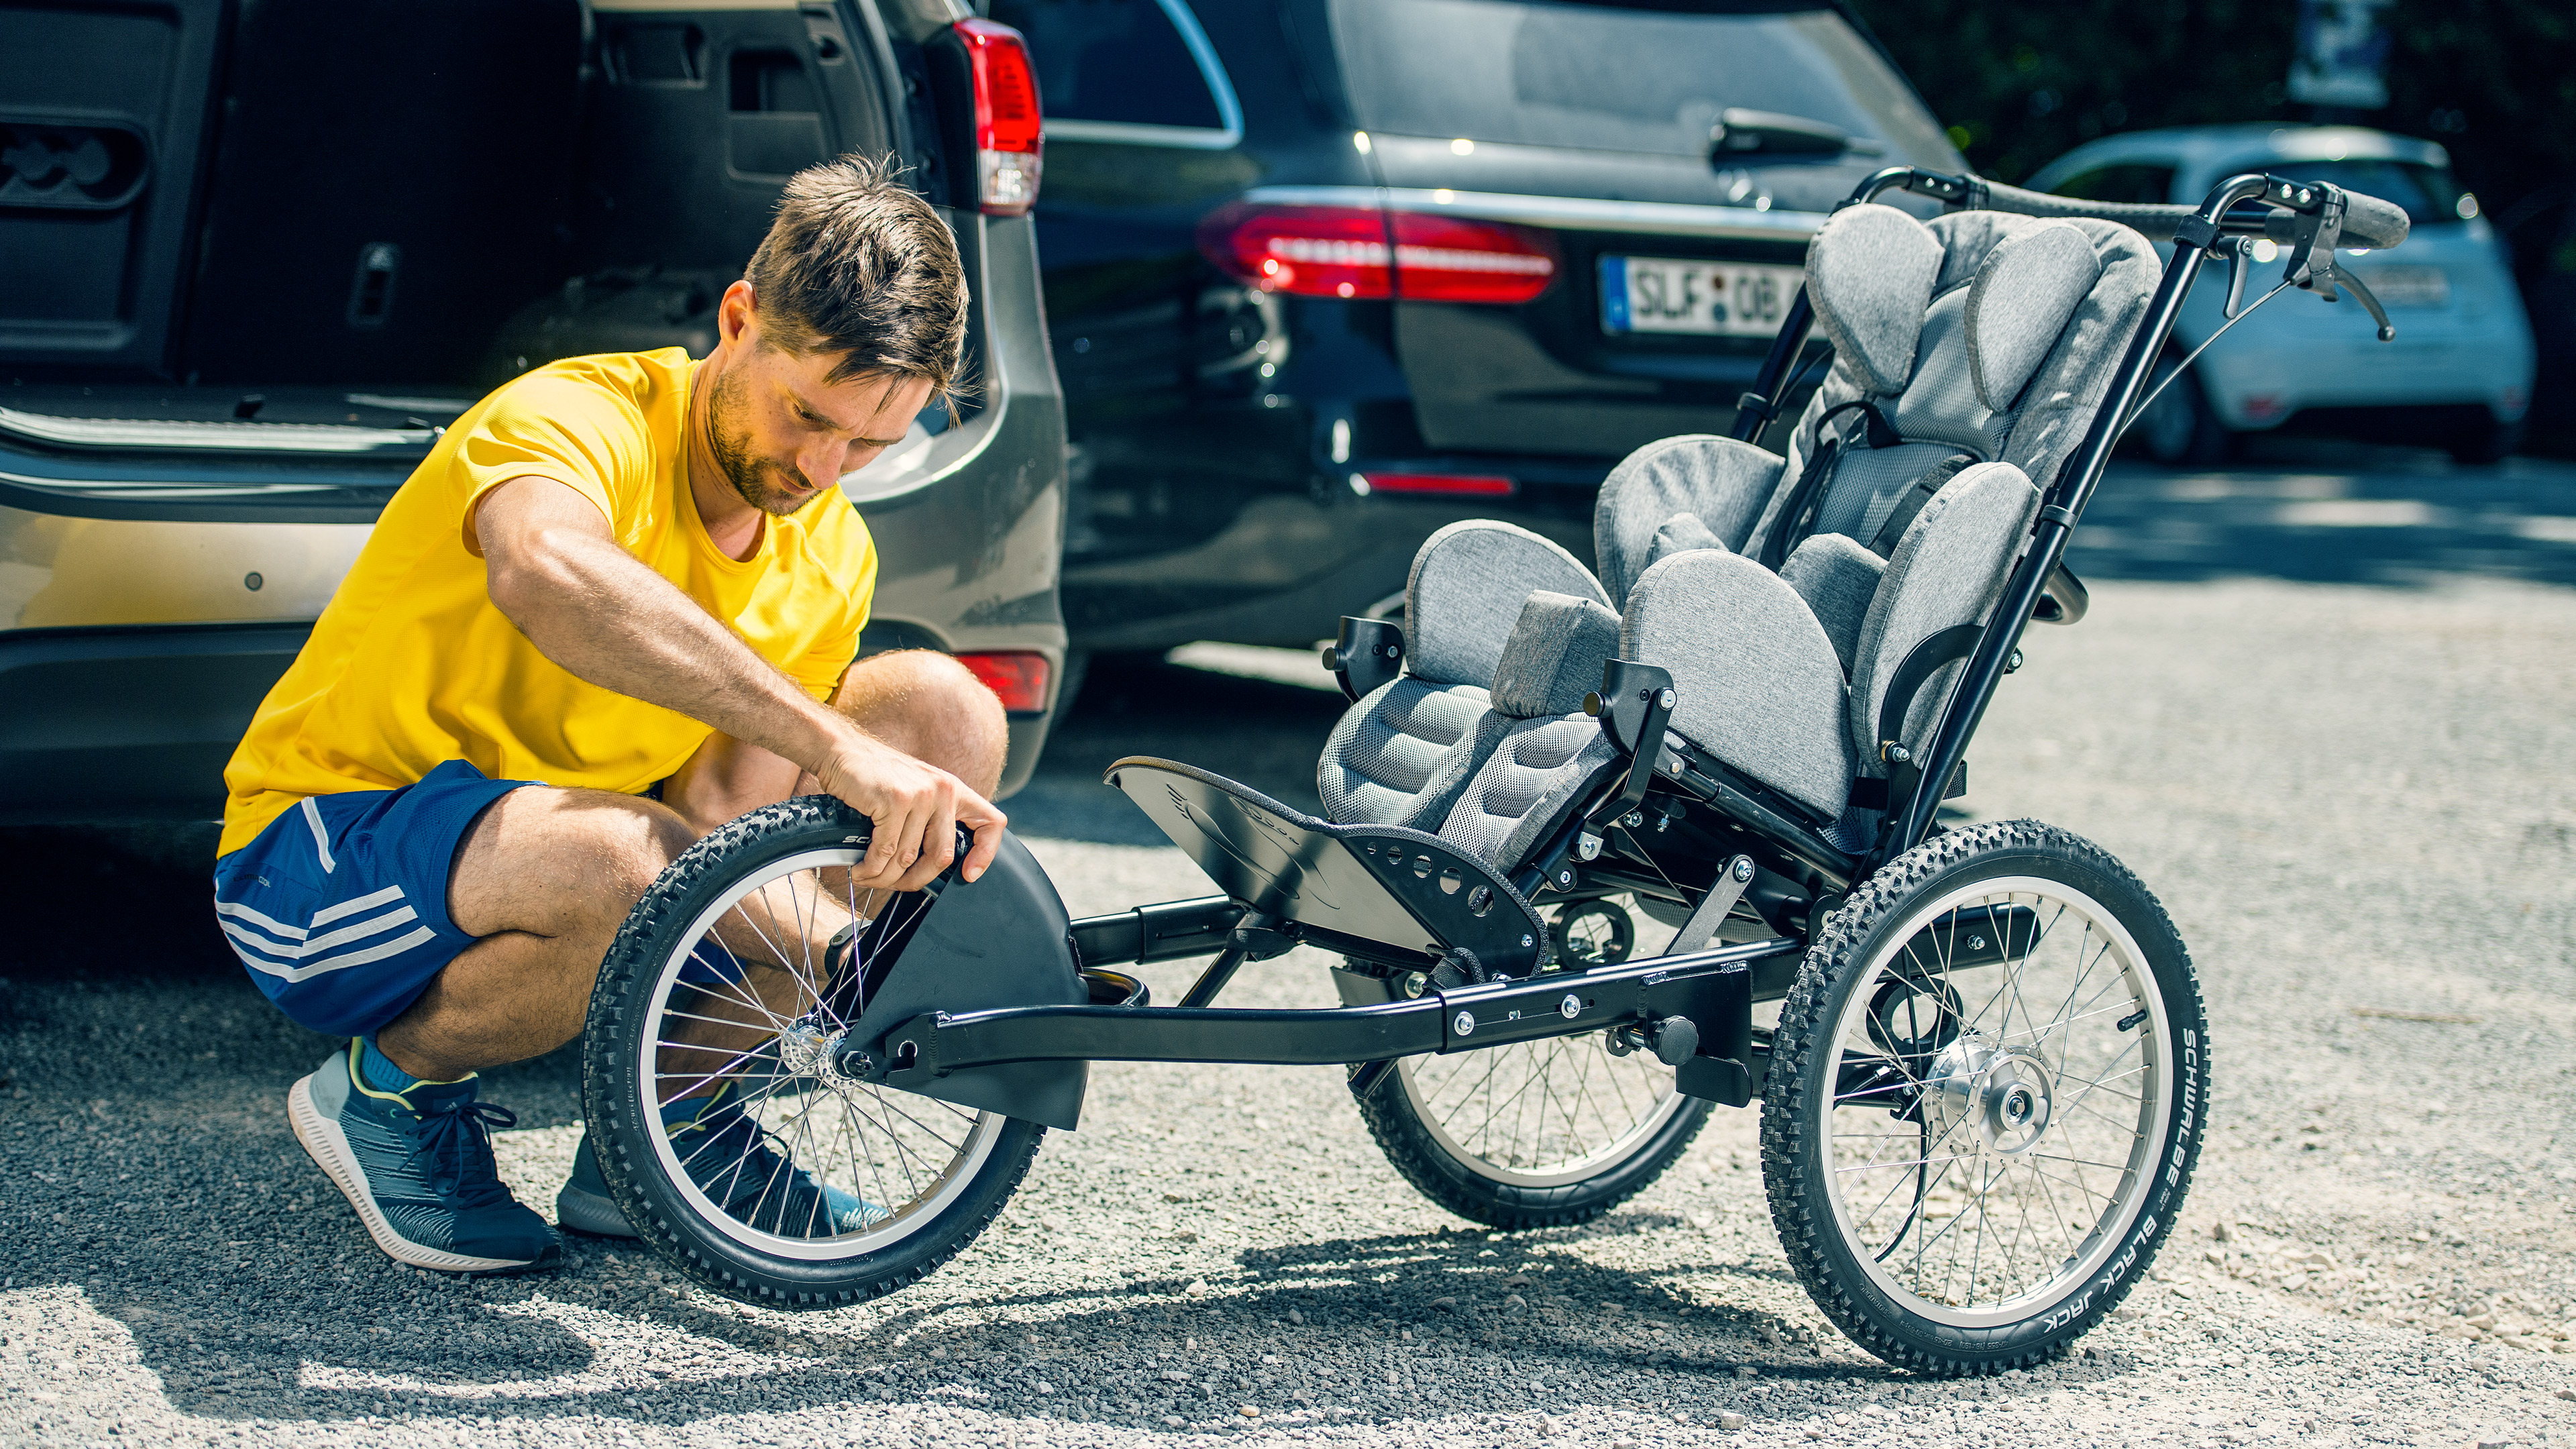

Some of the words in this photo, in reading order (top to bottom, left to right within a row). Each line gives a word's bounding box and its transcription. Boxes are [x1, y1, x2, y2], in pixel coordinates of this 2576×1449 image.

[1635, 269, 1699, 319] SLF
[2166, 1028, 2196, 1187] SCHWALBE
[2100, 1214, 2157, 1295] BLACK
[2043, 1290, 2092, 1333] JACK
